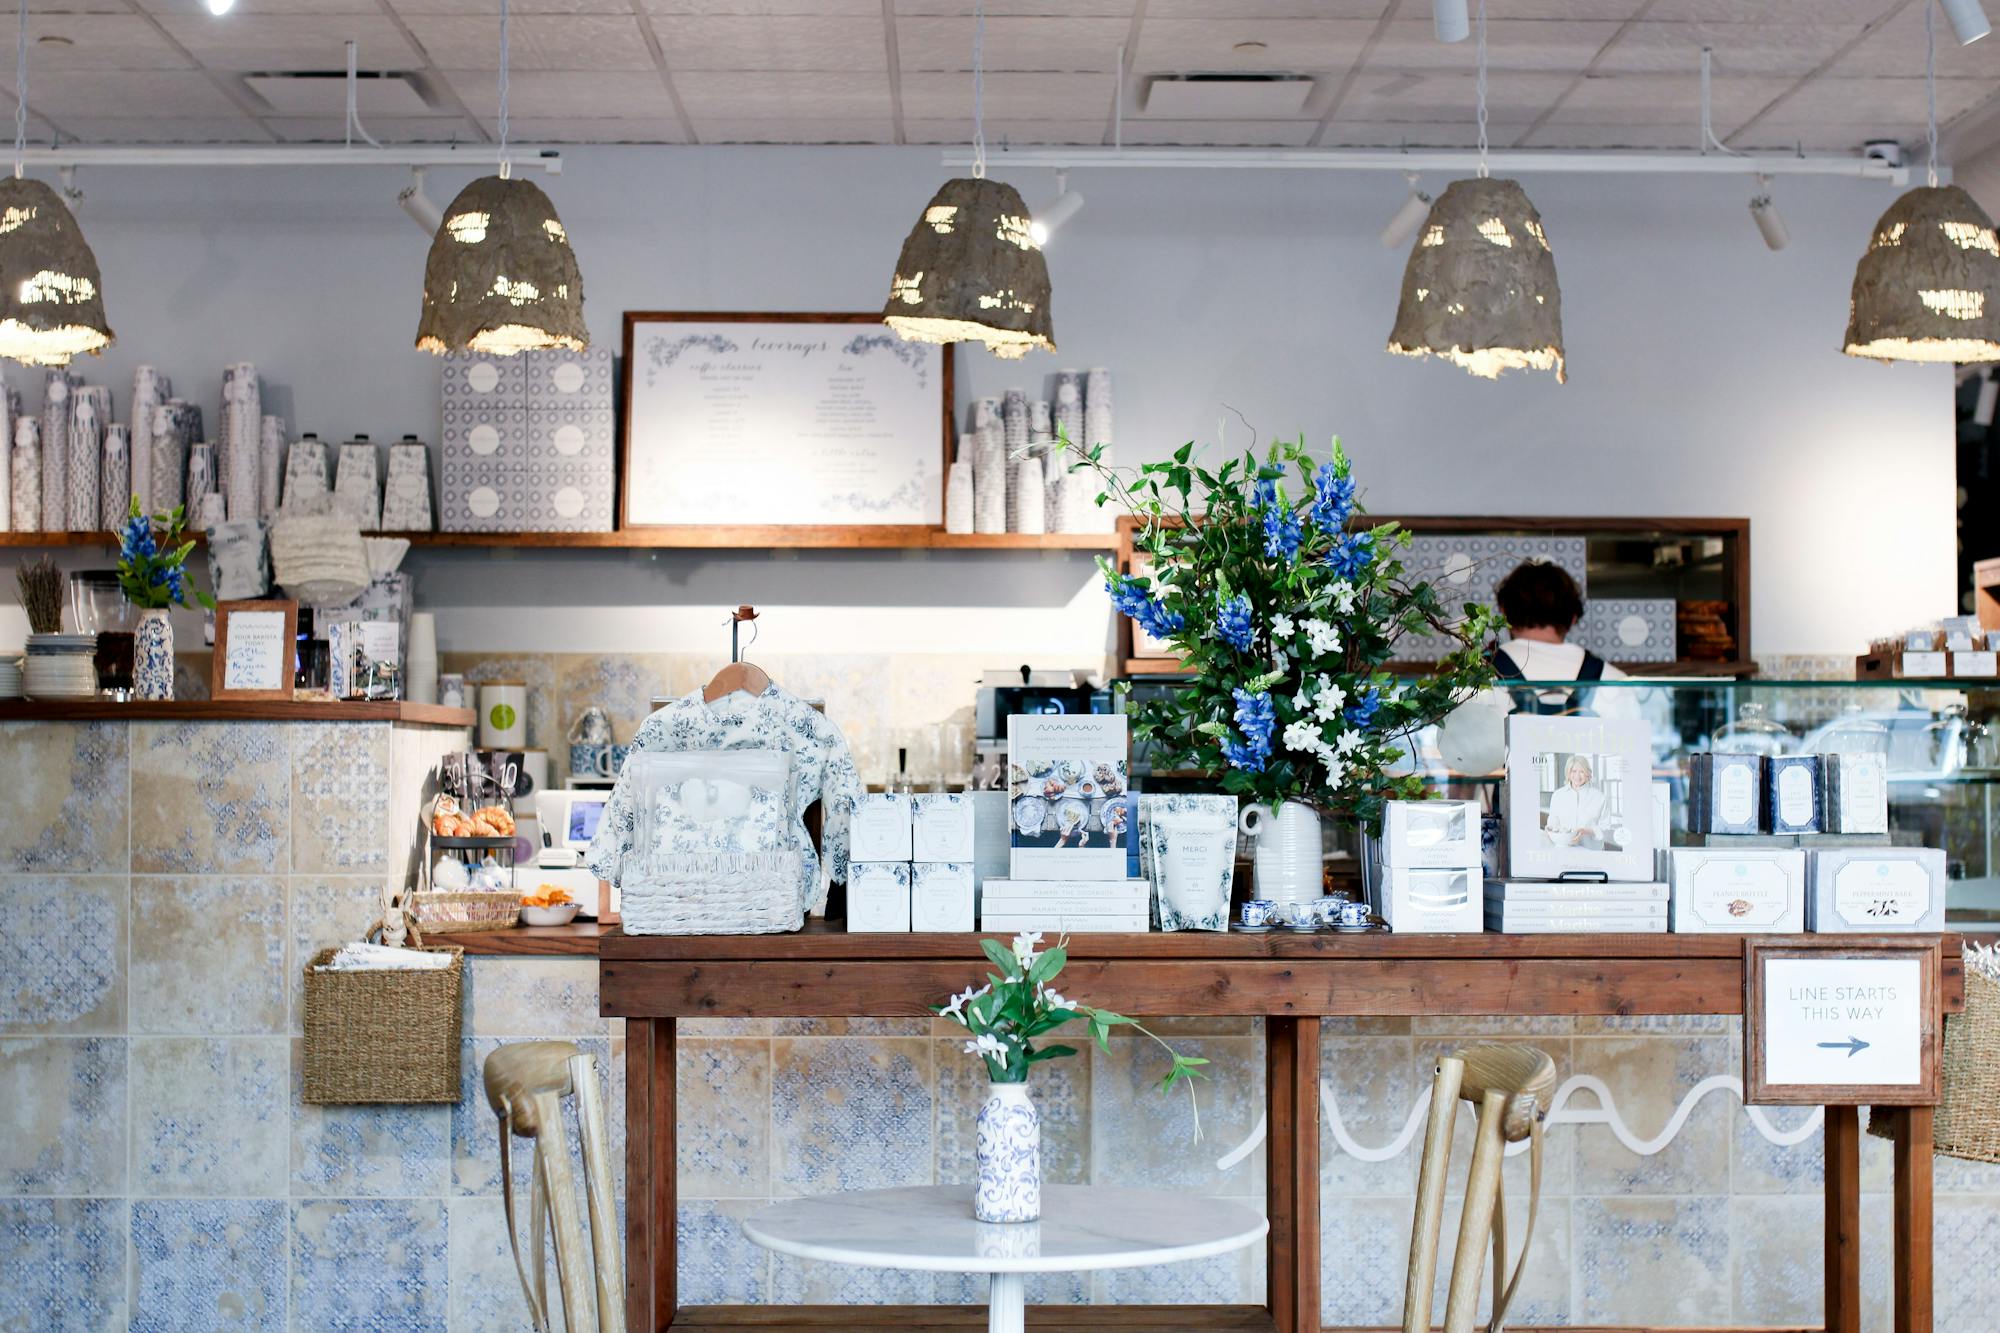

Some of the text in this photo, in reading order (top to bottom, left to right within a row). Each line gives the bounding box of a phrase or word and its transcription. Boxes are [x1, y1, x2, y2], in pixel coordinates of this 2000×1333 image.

[751, 338, 829, 357] beverages
[499, 762, 517, 788] 10
[1182, 845, 1209, 854] MERCI
[1789, 986, 1898, 1001] LINE STARTS
[1802, 1006, 1884, 1020] THIS WAY
